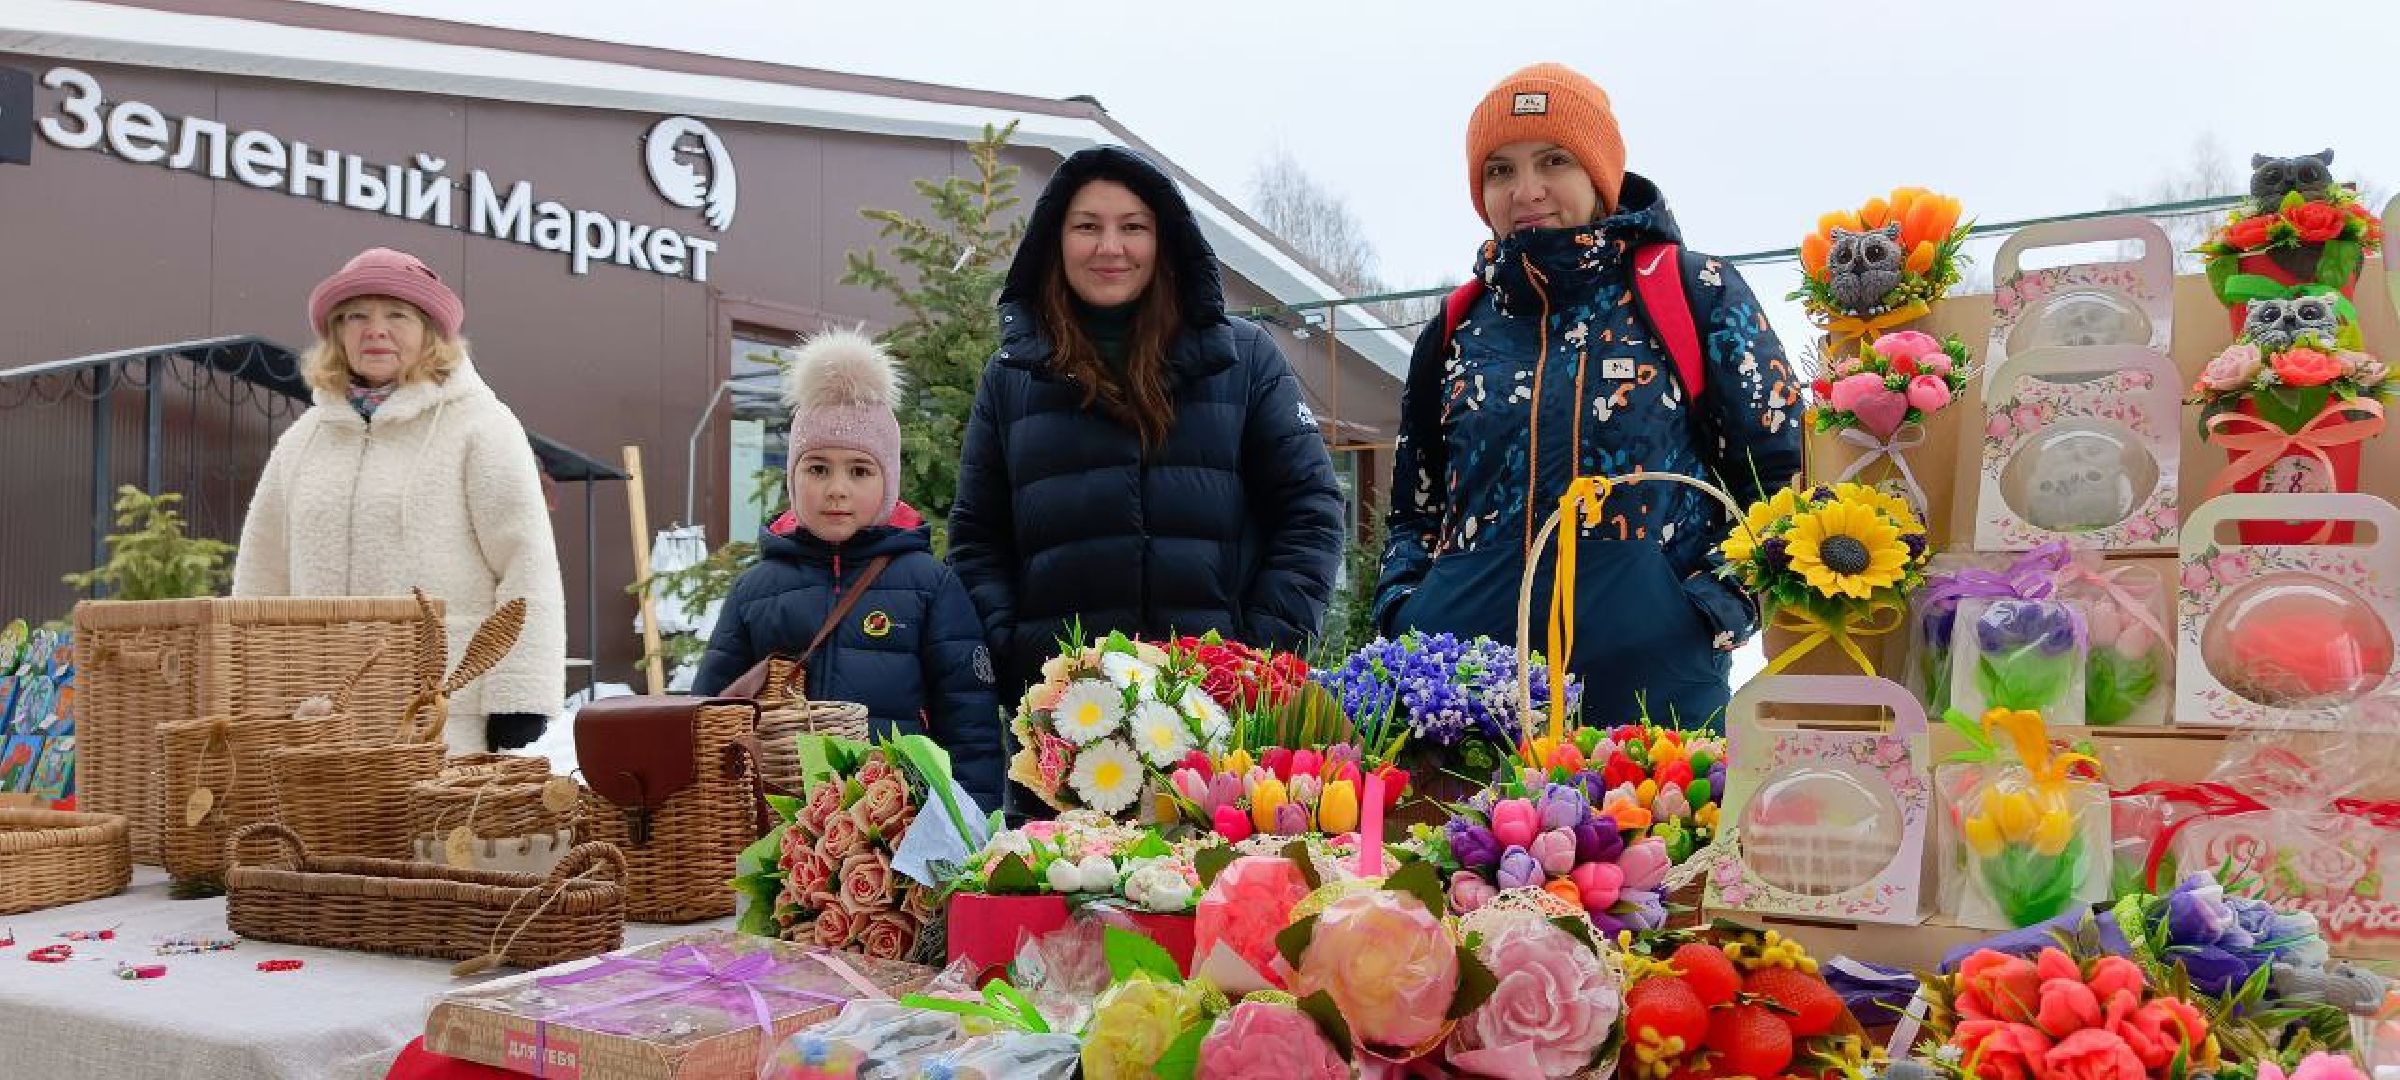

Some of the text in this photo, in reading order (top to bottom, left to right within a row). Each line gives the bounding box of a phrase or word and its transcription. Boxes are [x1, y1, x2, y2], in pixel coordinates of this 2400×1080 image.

[39, 65, 718, 282] Зеленый Маркет
[507, 1039, 537, 1061] ДЛЯ
[543, 1047, 576, 1069] ТЕБЯ
